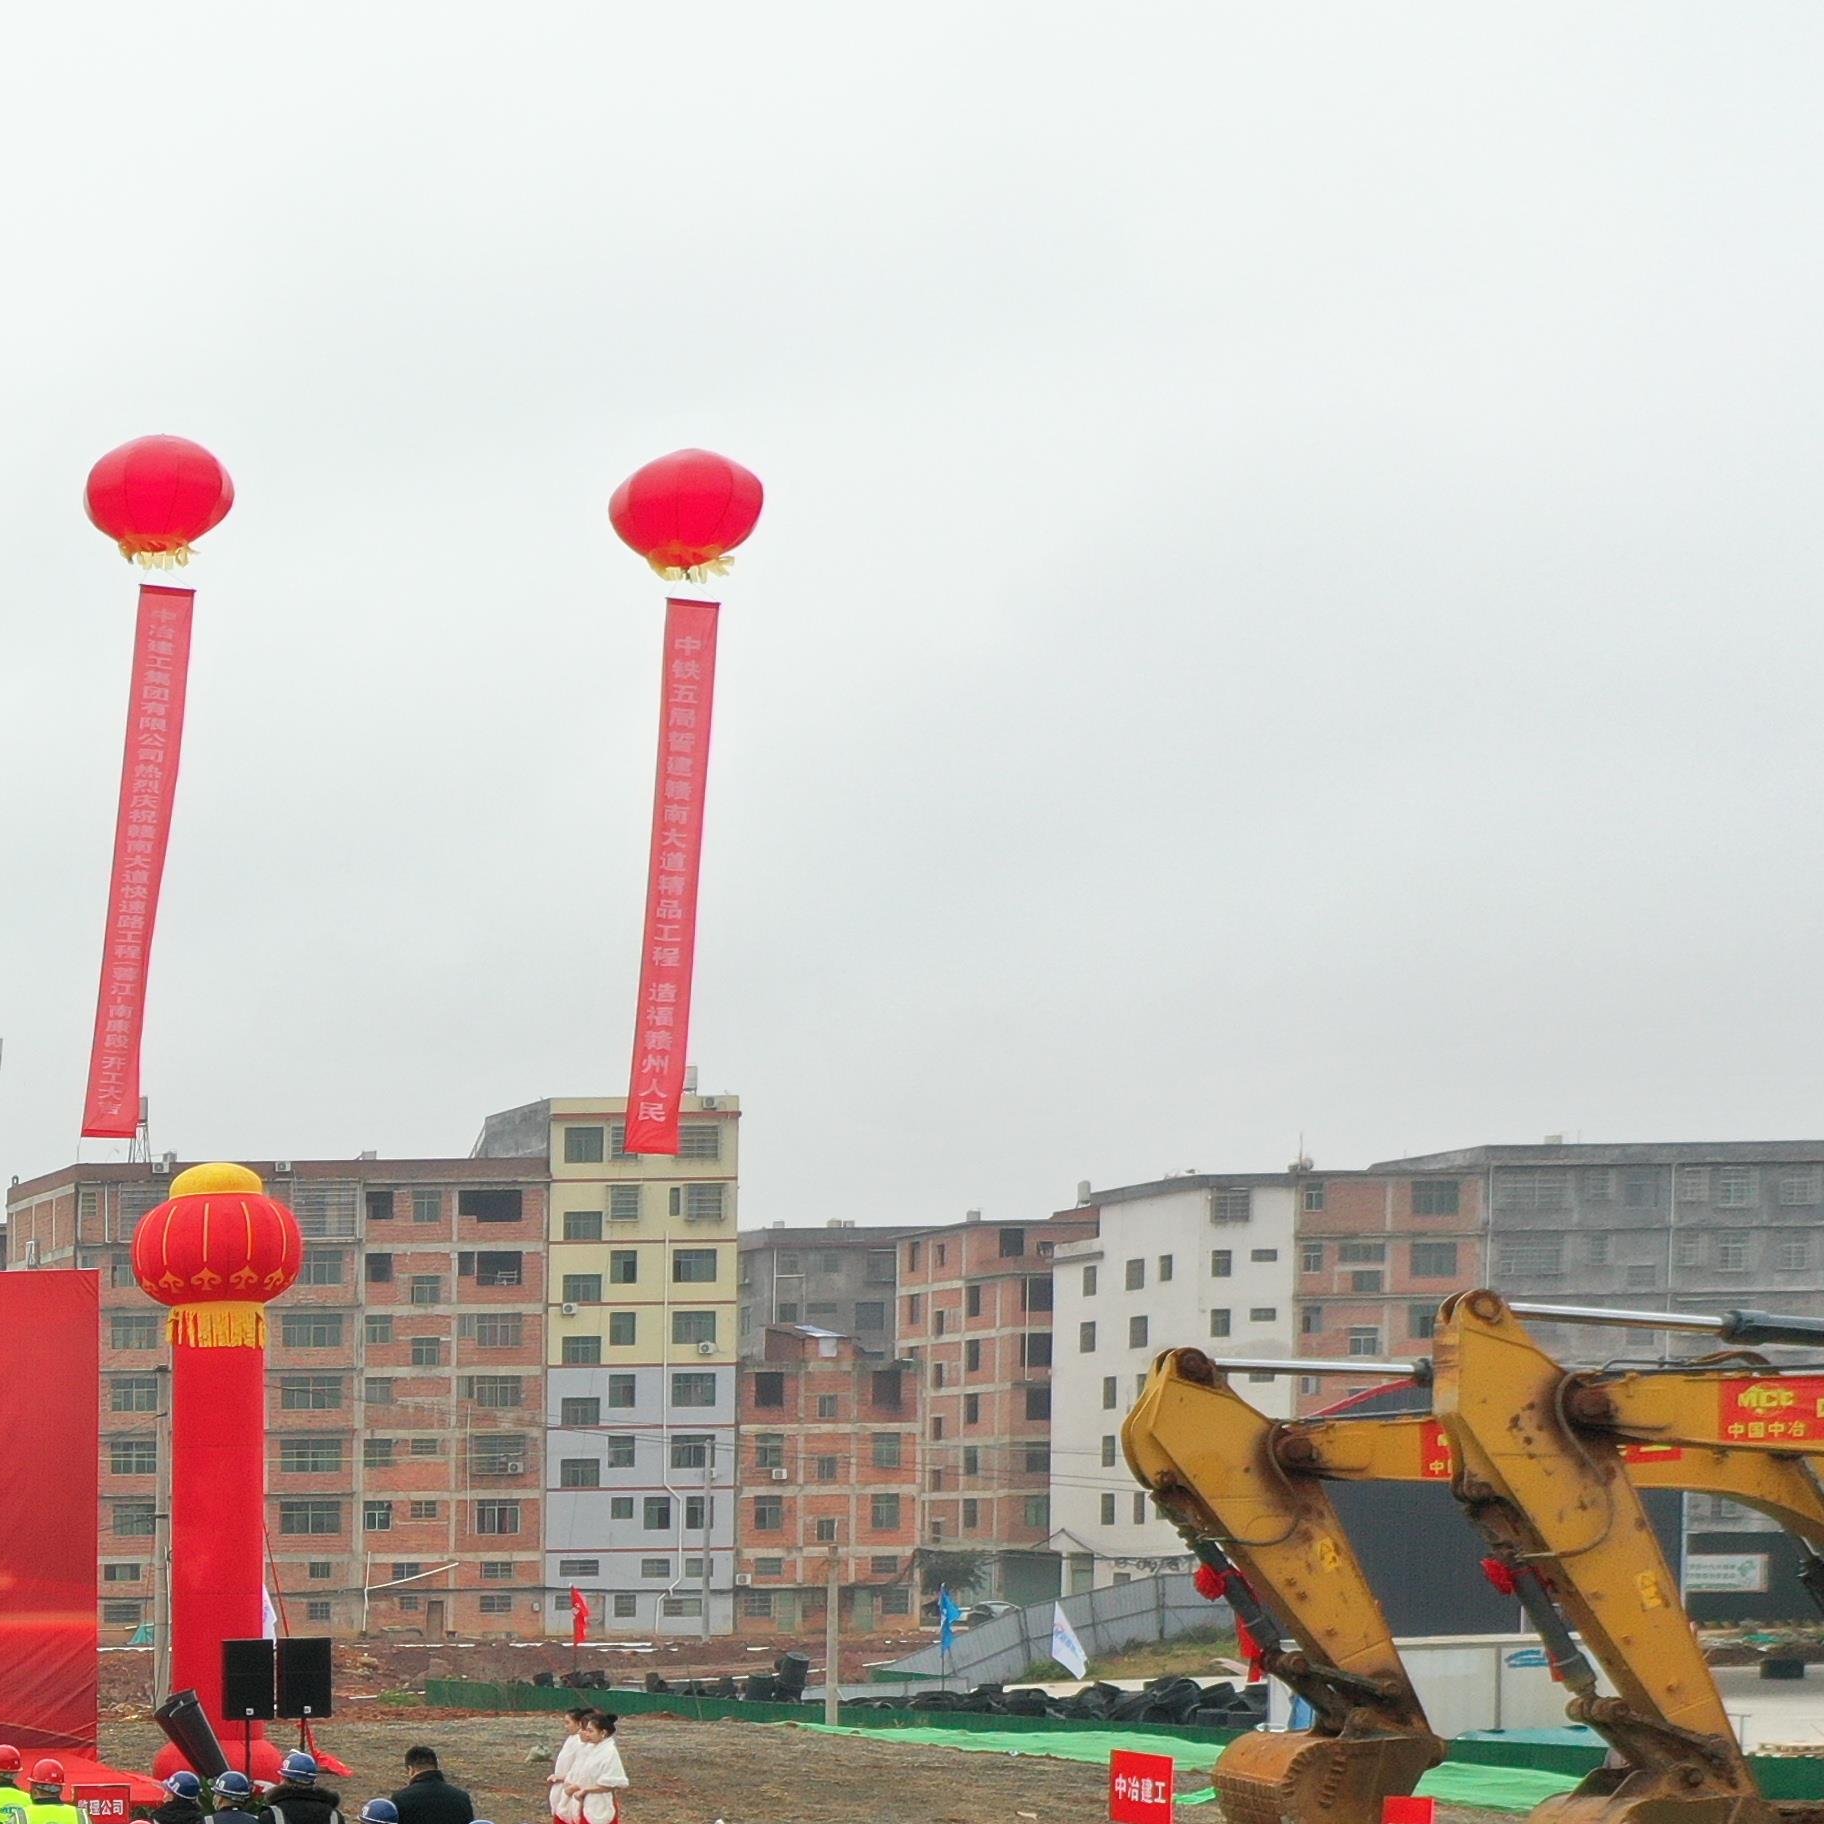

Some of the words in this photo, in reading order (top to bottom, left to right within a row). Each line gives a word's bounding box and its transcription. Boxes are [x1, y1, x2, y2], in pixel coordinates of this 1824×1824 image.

[637, 981, 677, 1123] 造福赣州人民
[1728, 1421, 1807, 1438] 中国中冶
[1115, 1773, 1166, 1804] 中冶建工
